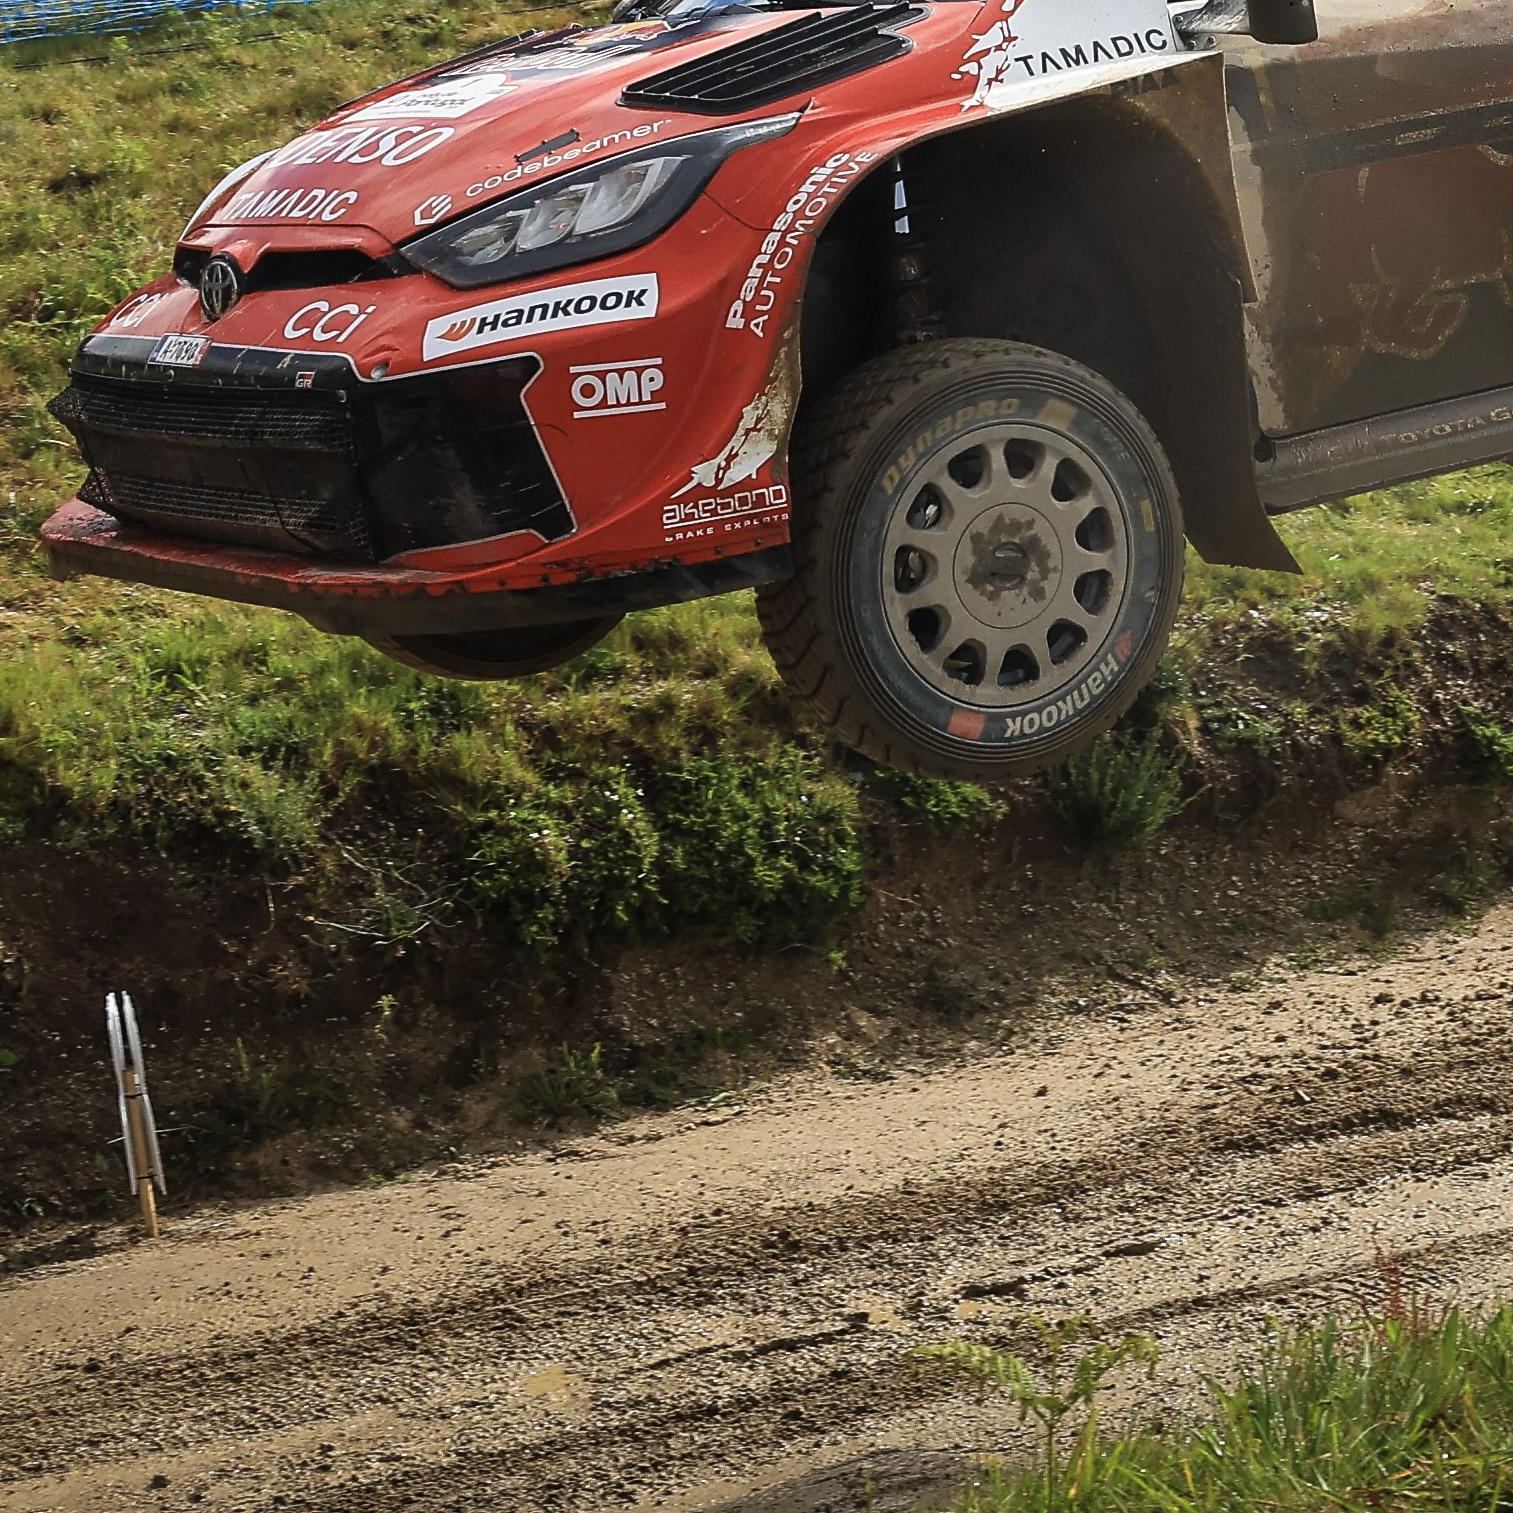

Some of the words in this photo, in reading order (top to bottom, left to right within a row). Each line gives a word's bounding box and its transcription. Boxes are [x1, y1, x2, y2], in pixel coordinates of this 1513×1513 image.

[1013, 28, 1168, 80] TAMADIC
[266, 125, 456, 167] DENSO
[465, 120, 666, 198] codebeamer
[725, 151, 851, 330] Panasonic
[749, 149, 878, 339] AUTOMOTIVE
[571, 364, 664, 407] OMP
